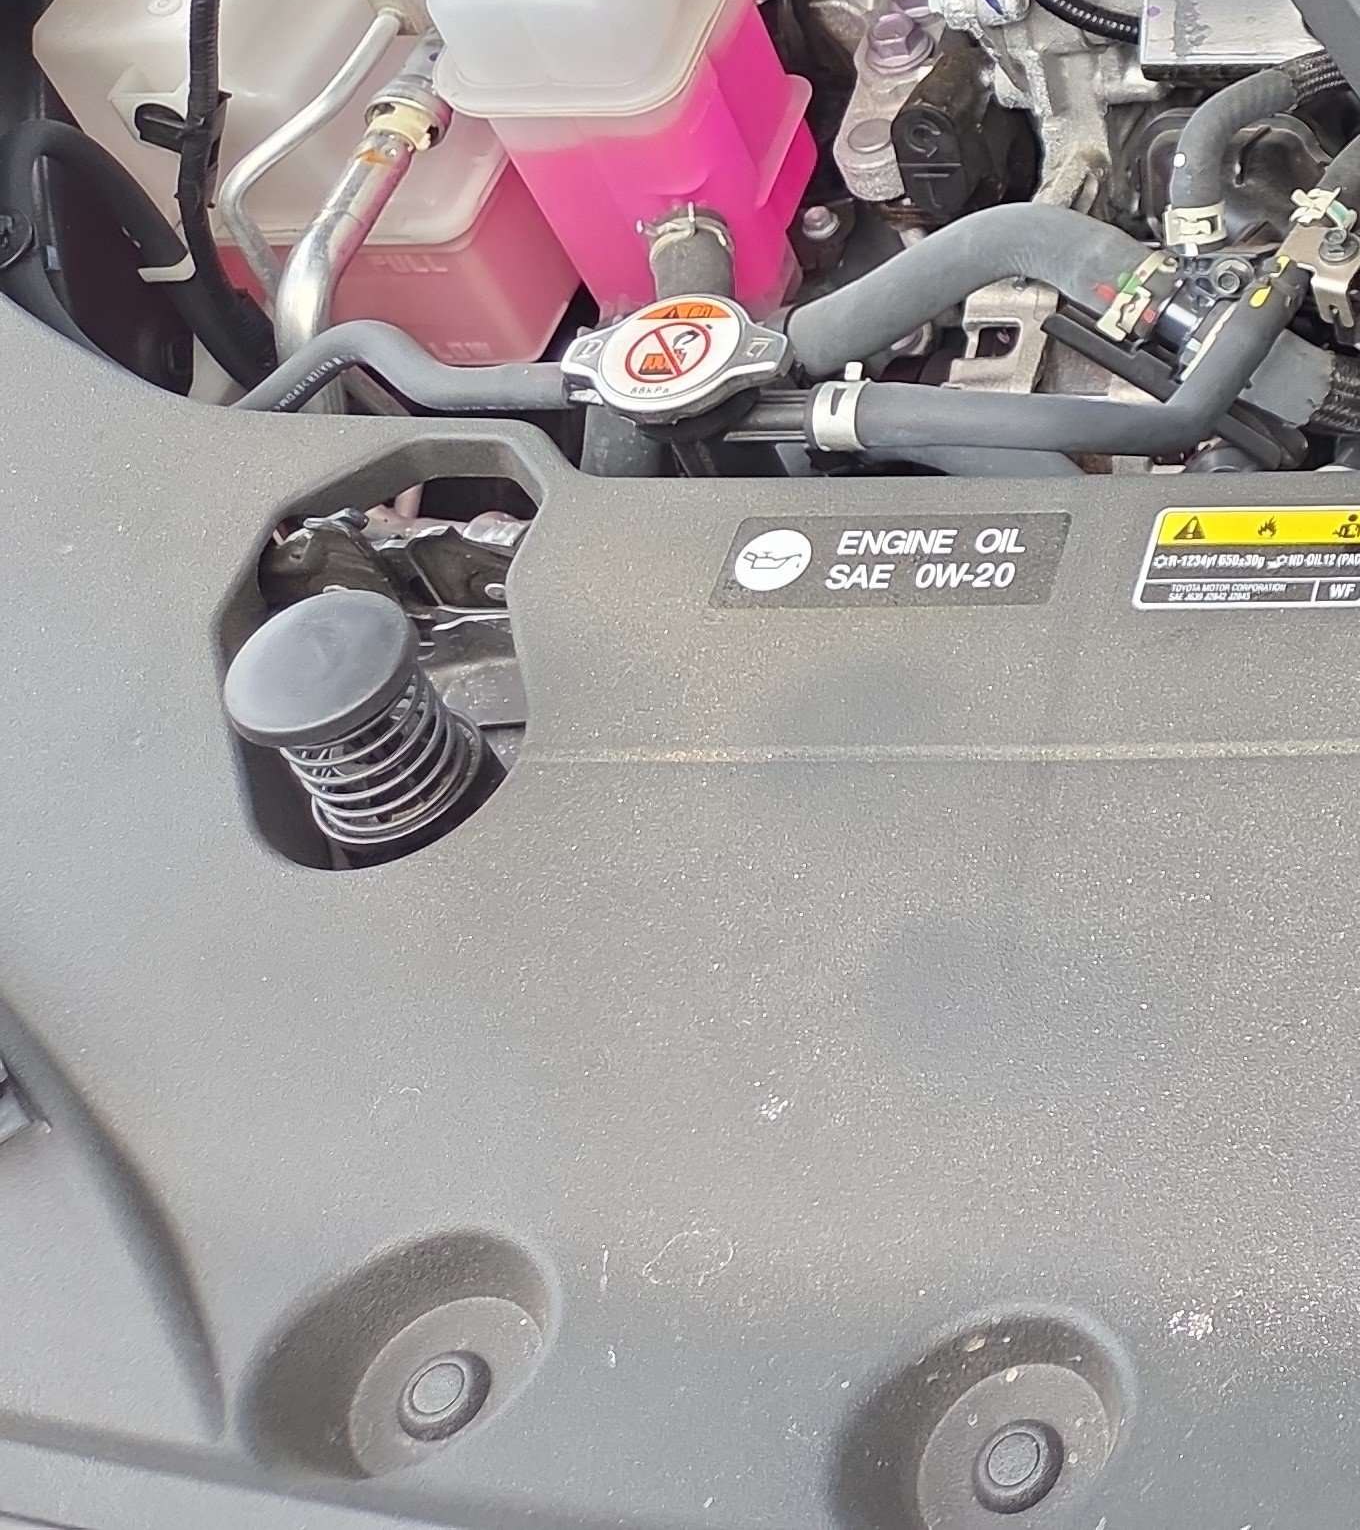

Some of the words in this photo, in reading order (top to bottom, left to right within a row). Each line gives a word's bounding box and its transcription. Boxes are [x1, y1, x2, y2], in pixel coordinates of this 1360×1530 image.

[837, 529, 957, 556] ENGINE
[975, 529, 1027, 554] OIL
[825, 564, 896, 591] SAE
[915, 563, 1016, 589] 0W-20
[1170, 583, 1201, 593] TOYOTA
[1202, 583, 1231, 592] MOTOR
[1327, 583, 1357, 599] WF
